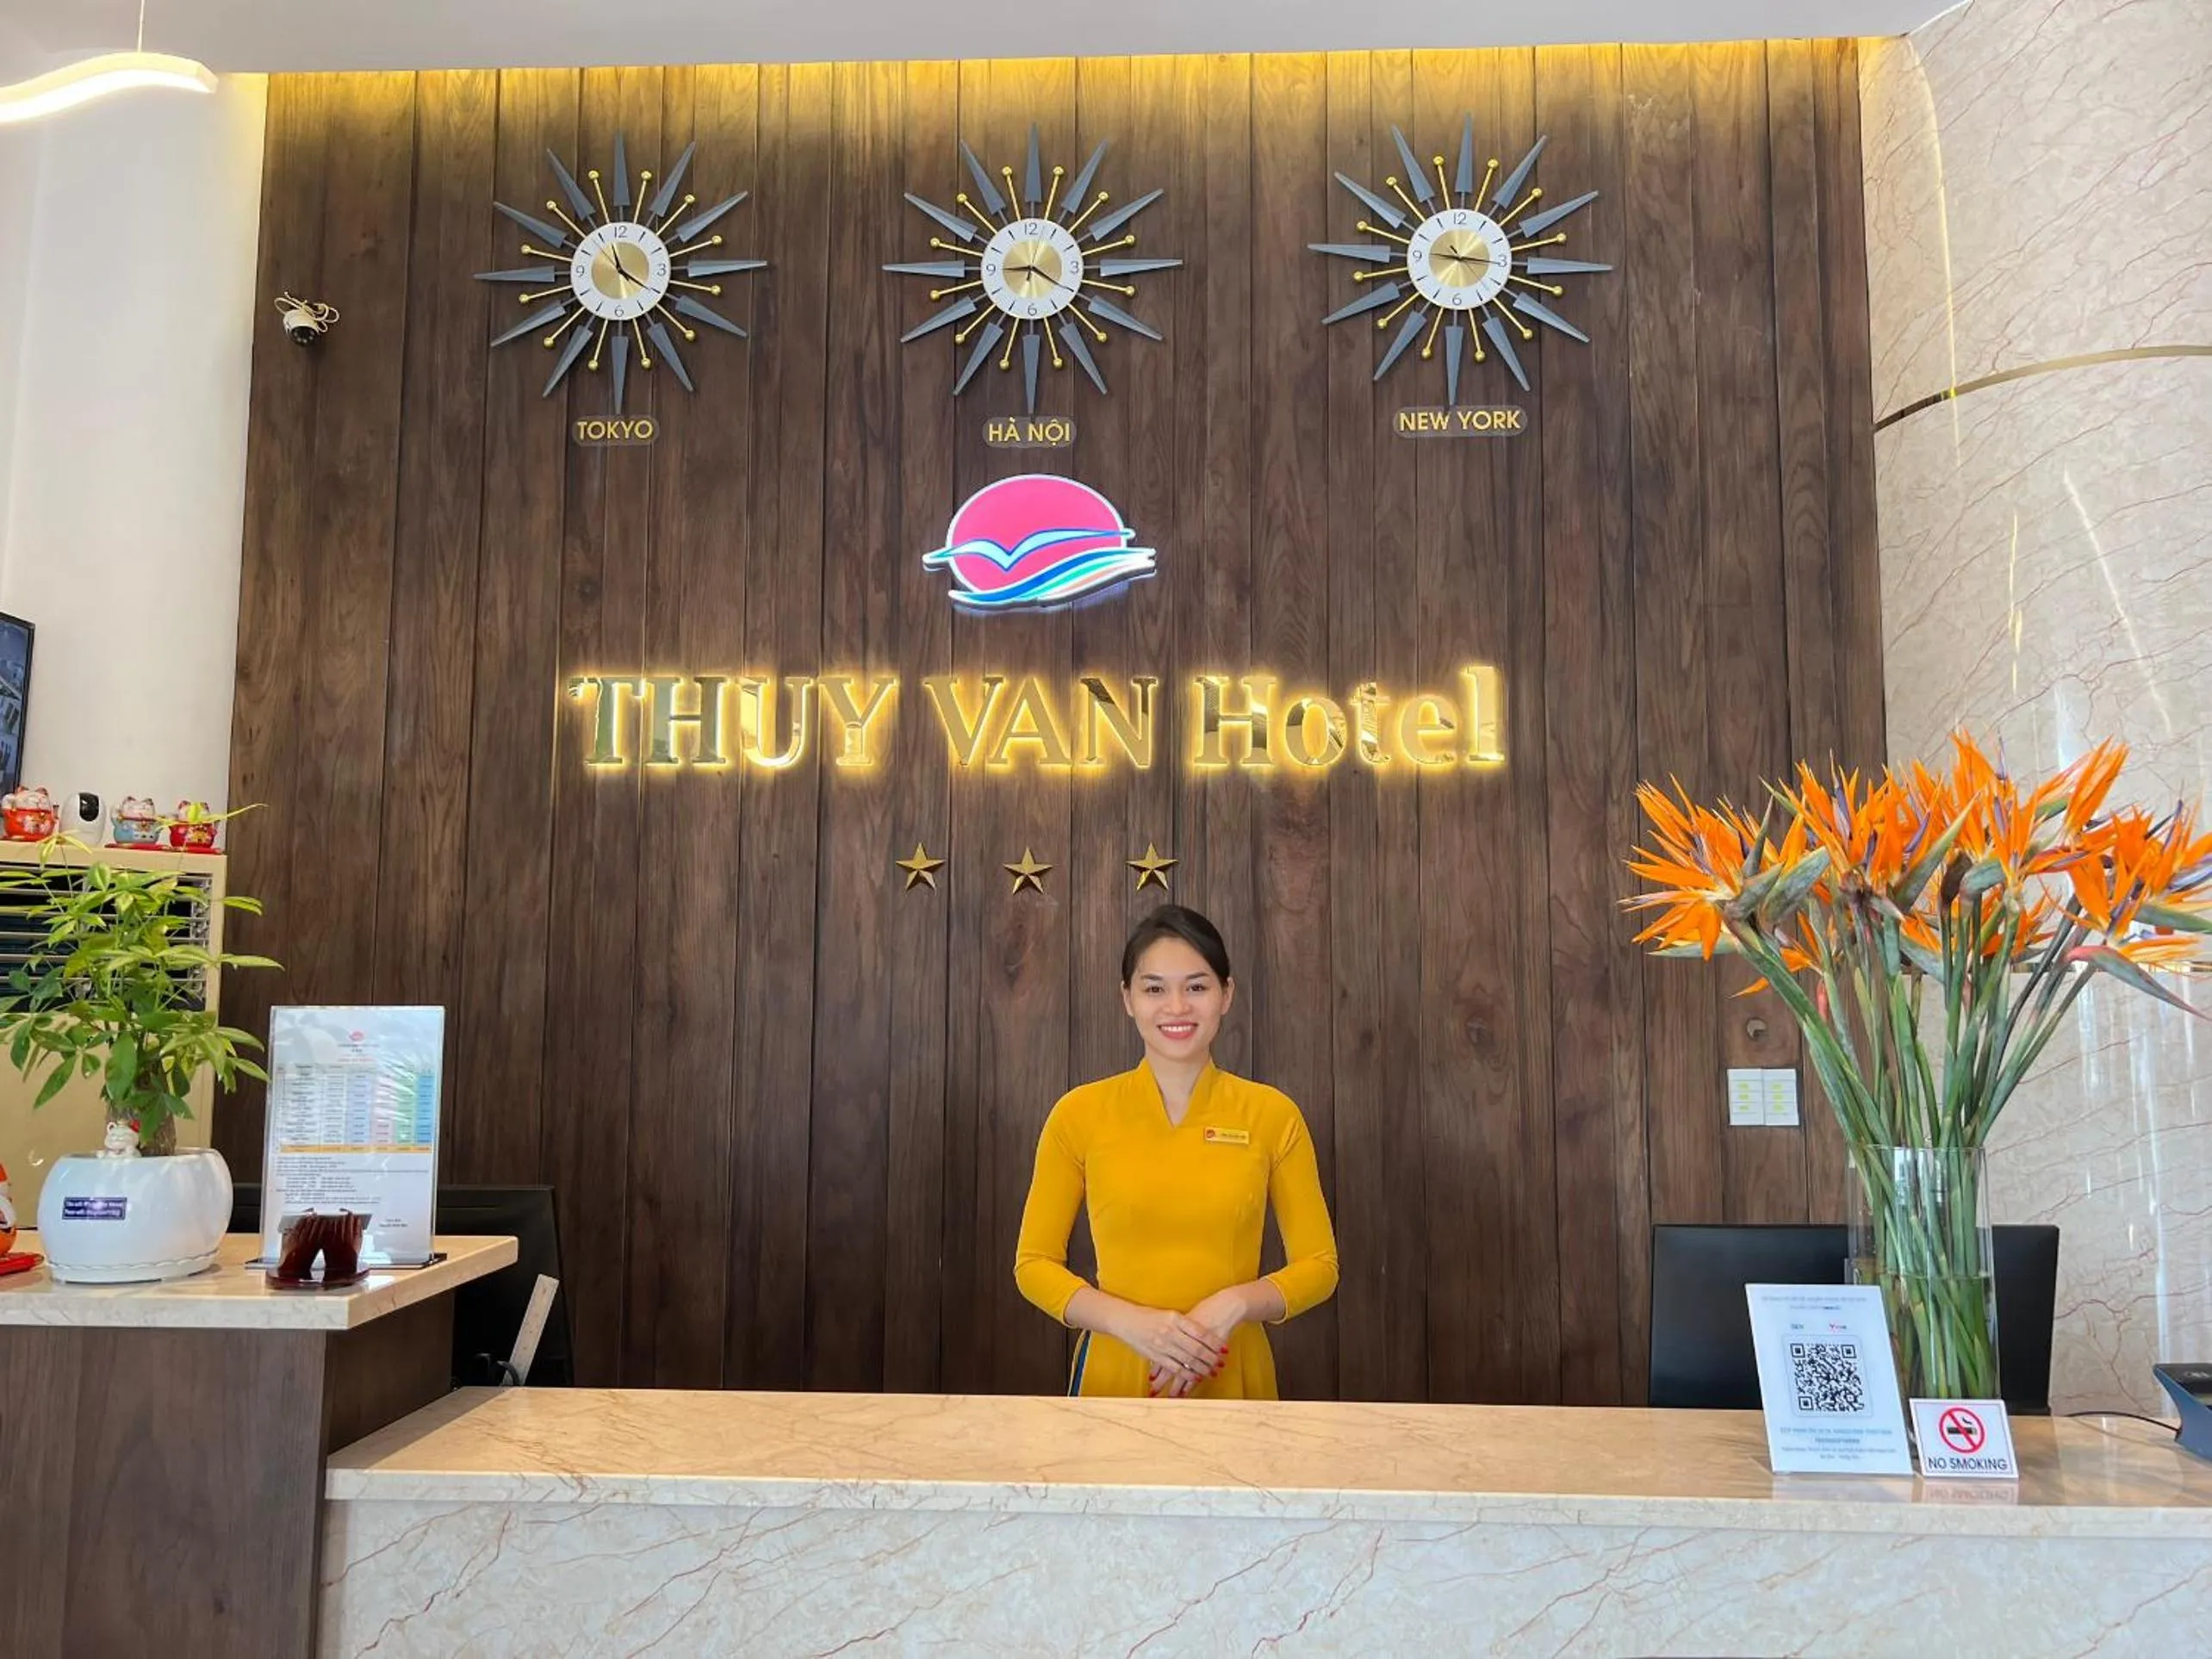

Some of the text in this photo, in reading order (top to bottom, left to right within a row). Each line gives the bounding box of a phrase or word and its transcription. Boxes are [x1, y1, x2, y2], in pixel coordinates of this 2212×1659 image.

[1453, 212, 1467, 225] 12
[613, 225, 628, 239] 12
[1024, 222, 1039, 235] 12
[1412, 250, 1422, 262] 9
[1497, 254, 1507, 268] 3
[575, 264, 585, 277] 9
[656, 263, 667, 276] 3
[985, 263, 997, 276] 9
[1069, 260, 1079, 275] 3
[1451, 293, 1463, 306] 6
[614, 304, 624, 317] 6
[1027, 302, 1038, 316] 6
[1400, 410, 1521, 431] NEW YORK
[577, 419, 653, 440] TOKYO
[988, 416, 1070, 446] HÀ NỘI
[568, 665, 1505, 768] THUY VAN Hotel
[1928, 1457, 2008, 1470] NO SMOKING
